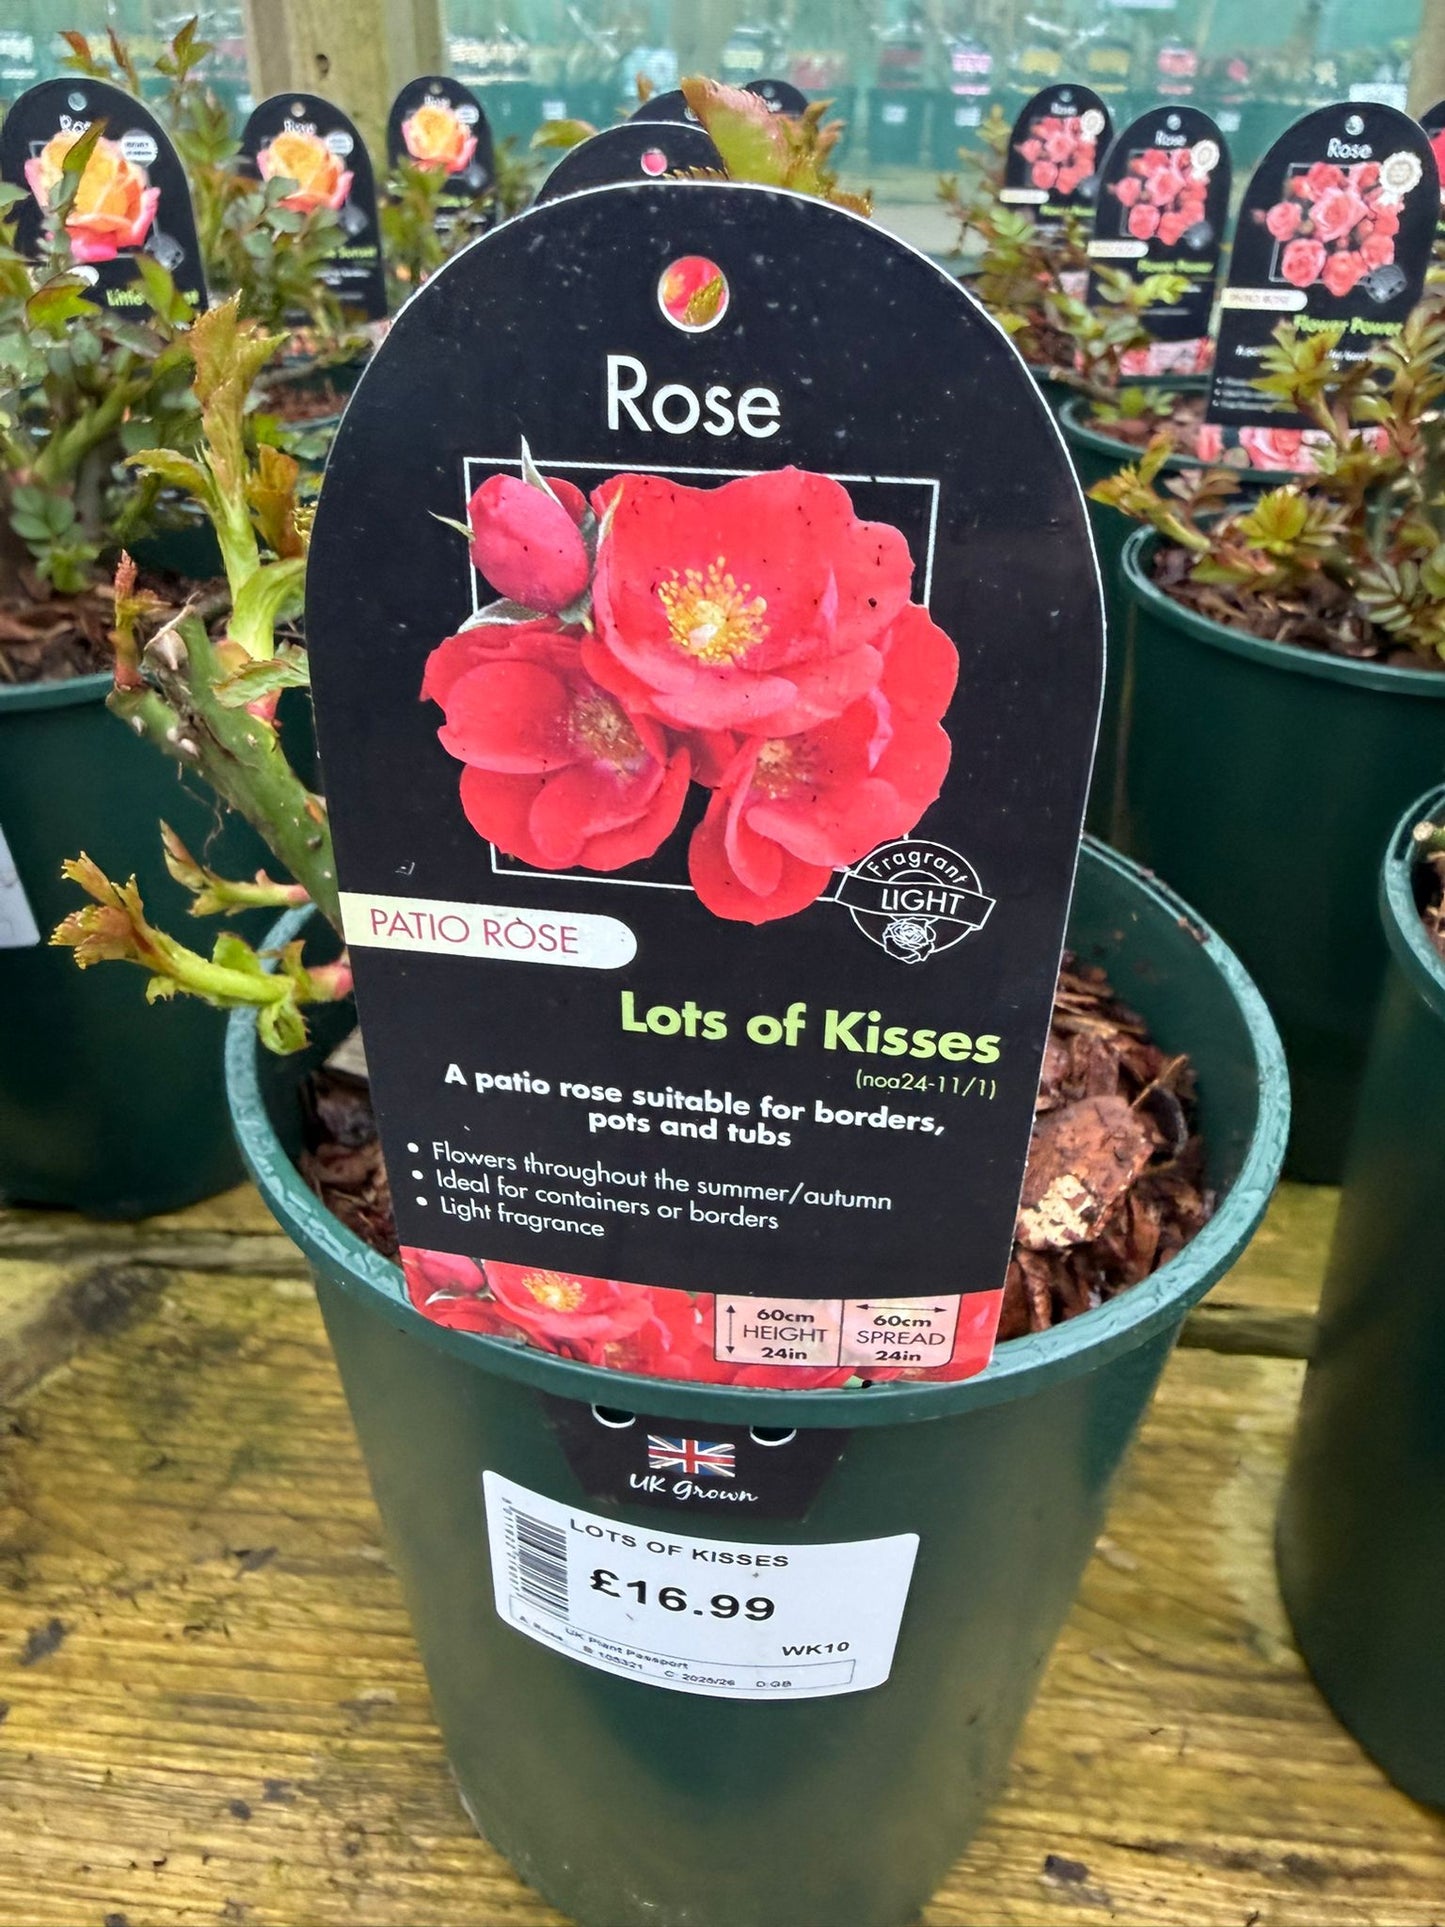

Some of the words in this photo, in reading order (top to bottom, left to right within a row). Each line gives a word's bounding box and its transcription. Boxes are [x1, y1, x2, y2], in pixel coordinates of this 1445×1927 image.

[59, 115, 93, 133] Ros
[1155, 130, 1186, 147] Rose
[1327, 137, 1373, 160] Rose
[1294, 314, 1349, 334] Flower
[1350, 317, 1403, 337] Power
[607, 355, 781, 438] Rose
[866, 850, 969, 884] Fragrant
[881, 888, 965, 915] LIGHT
[370, 908, 470, 943] PATIO
[483, 917, 579, 954] ROSE
[620, 990, 728, 1040] Lots
[746, 1002, 807, 1047] of
[823, 1009, 1001, 1064] Kisses
[855, 1068, 997, 1100] (noa24-11/1)
[444, 1063, 468, 1086] A
[475, 1070, 550, 1095] patio
[560, 1081, 623, 1103] rose
[632, 1085, 750, 1117] suitable
[759, 1094, 806, 1122] for
[814, 1100, 945, 1137] borders,
[588, 1111, 651, 1133] pots
[660, 1118, 718, 1141] and
[727, 1122, 792, 1147] tubs
[432, 1141, 517, 1171] Flowers
[524, 1152, 648, 1187] throughout
[654, 1168, 690, 1192] the
[697, 1182, 892, 1211] summer/autumn
[436, 1168, 490, 1194] Ideal
[497, 1176, 528, 1199] for
[535, 1192, 650, 1217] containers
[657, 1204, 683, 1219] or
[689, 1200, 780, 1229] borders
[440, 1196, 492, 1222] Light
[497, 1202, 605, 1237] fragrance
[756, 1309, 815, 1324] 60cm
[873, 1315, 932, 1328] 60cm
[743, 1325, 829, 1343] HEIGHT
[856, 1330, 946, 1346] SPREAD
[761, 1347, 808, 1361] 24in
[875, 1350, 922, 1363] 24in
[629, 1473, 667, 1493] UK
[672, 1480, 759, 1502] Grown
[570, 1518, 637, 1548] LOTS
[646, 1541, 684, 1556] OF
[692, 1548, 789, 1568] KISSES
[589, 1568, 775, 1622] £16.99
[589, 1637, 623, 1654] Plant
[782, 1641, 850, 1656] WK10
